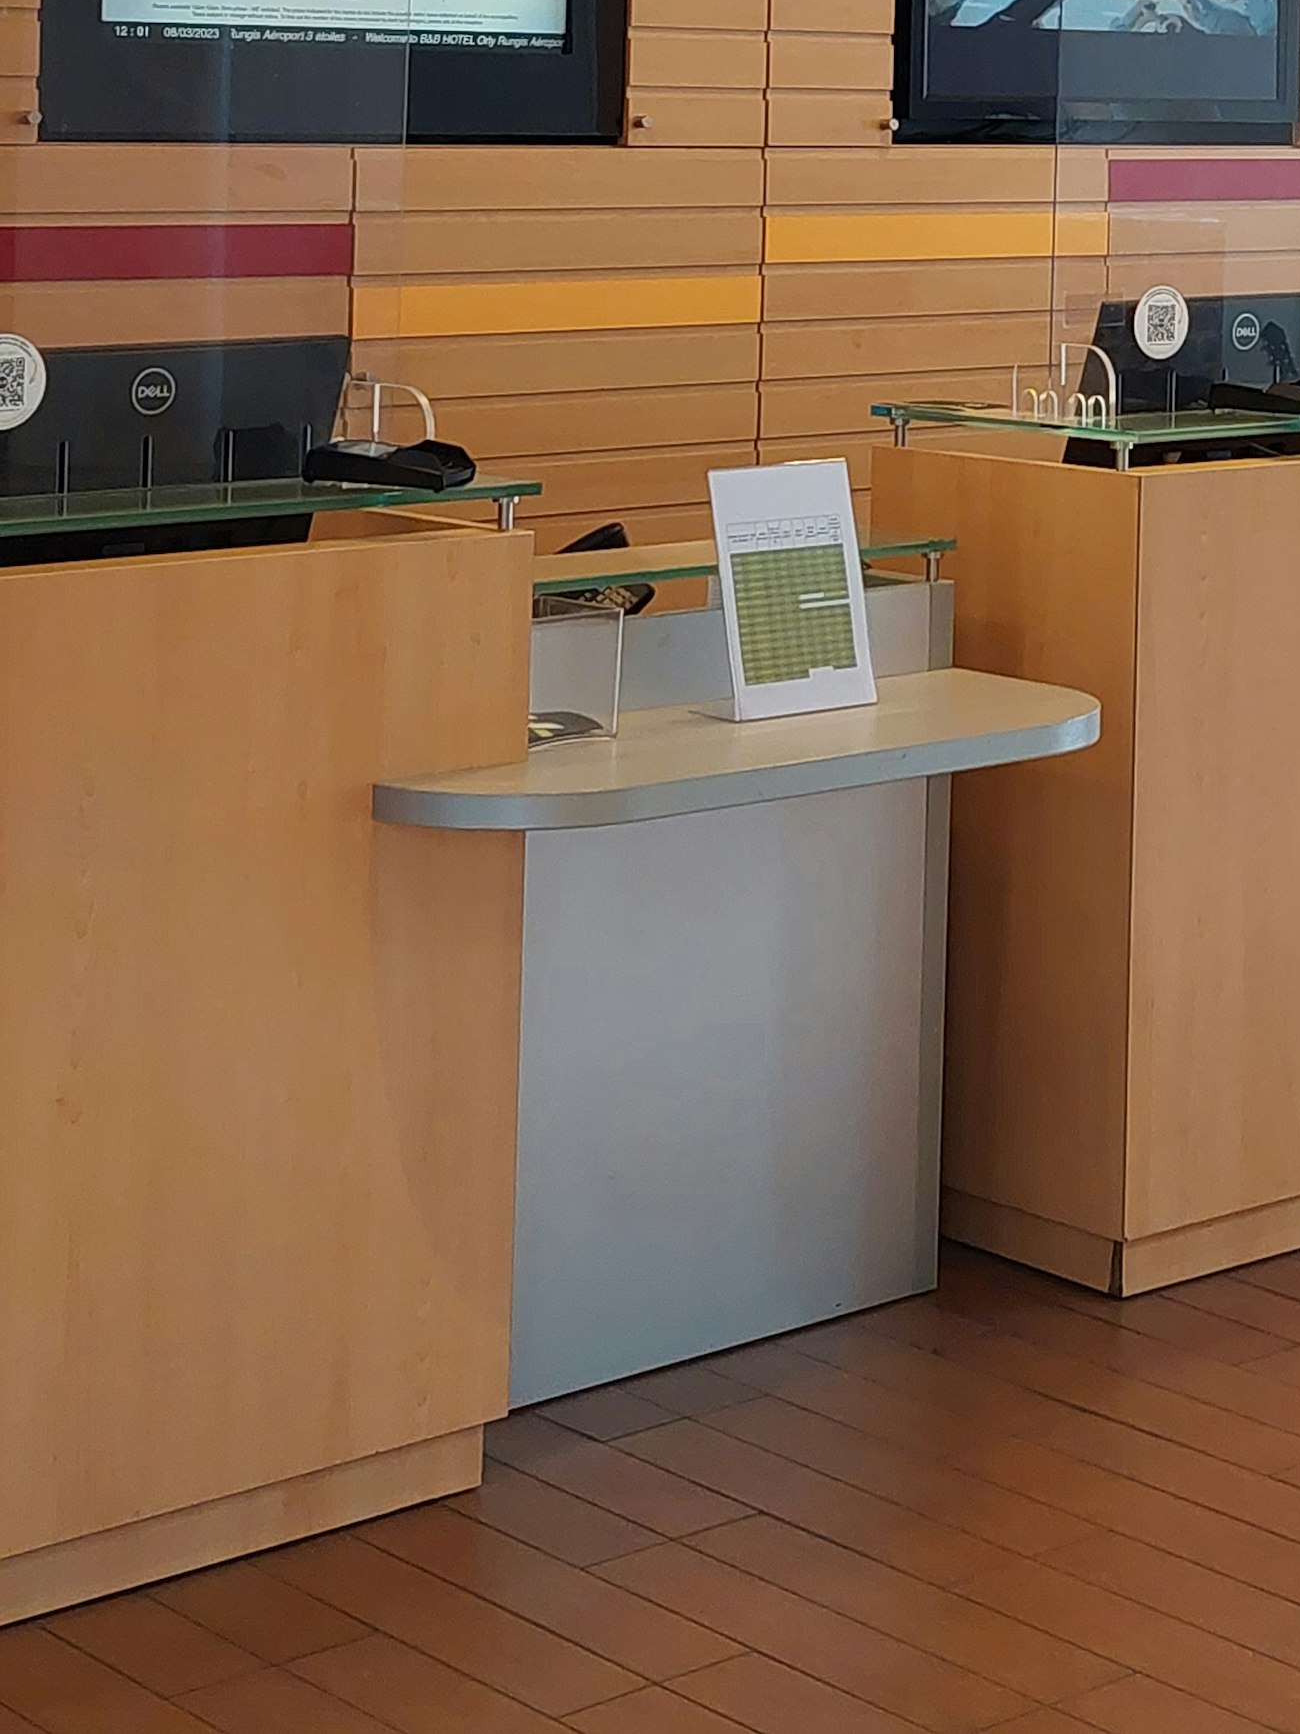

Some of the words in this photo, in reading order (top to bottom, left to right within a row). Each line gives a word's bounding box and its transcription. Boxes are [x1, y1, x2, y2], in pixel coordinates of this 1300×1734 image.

[420, 34, 440, 44] B&B
[441, 34, 475, 46] HOTEL
[477, 35, 496, 48] Orly
[497, 35, 529, 48] Rungis
[1236, 326, 1256, 337] DELL
[137, 384, 170, 399] DELL
